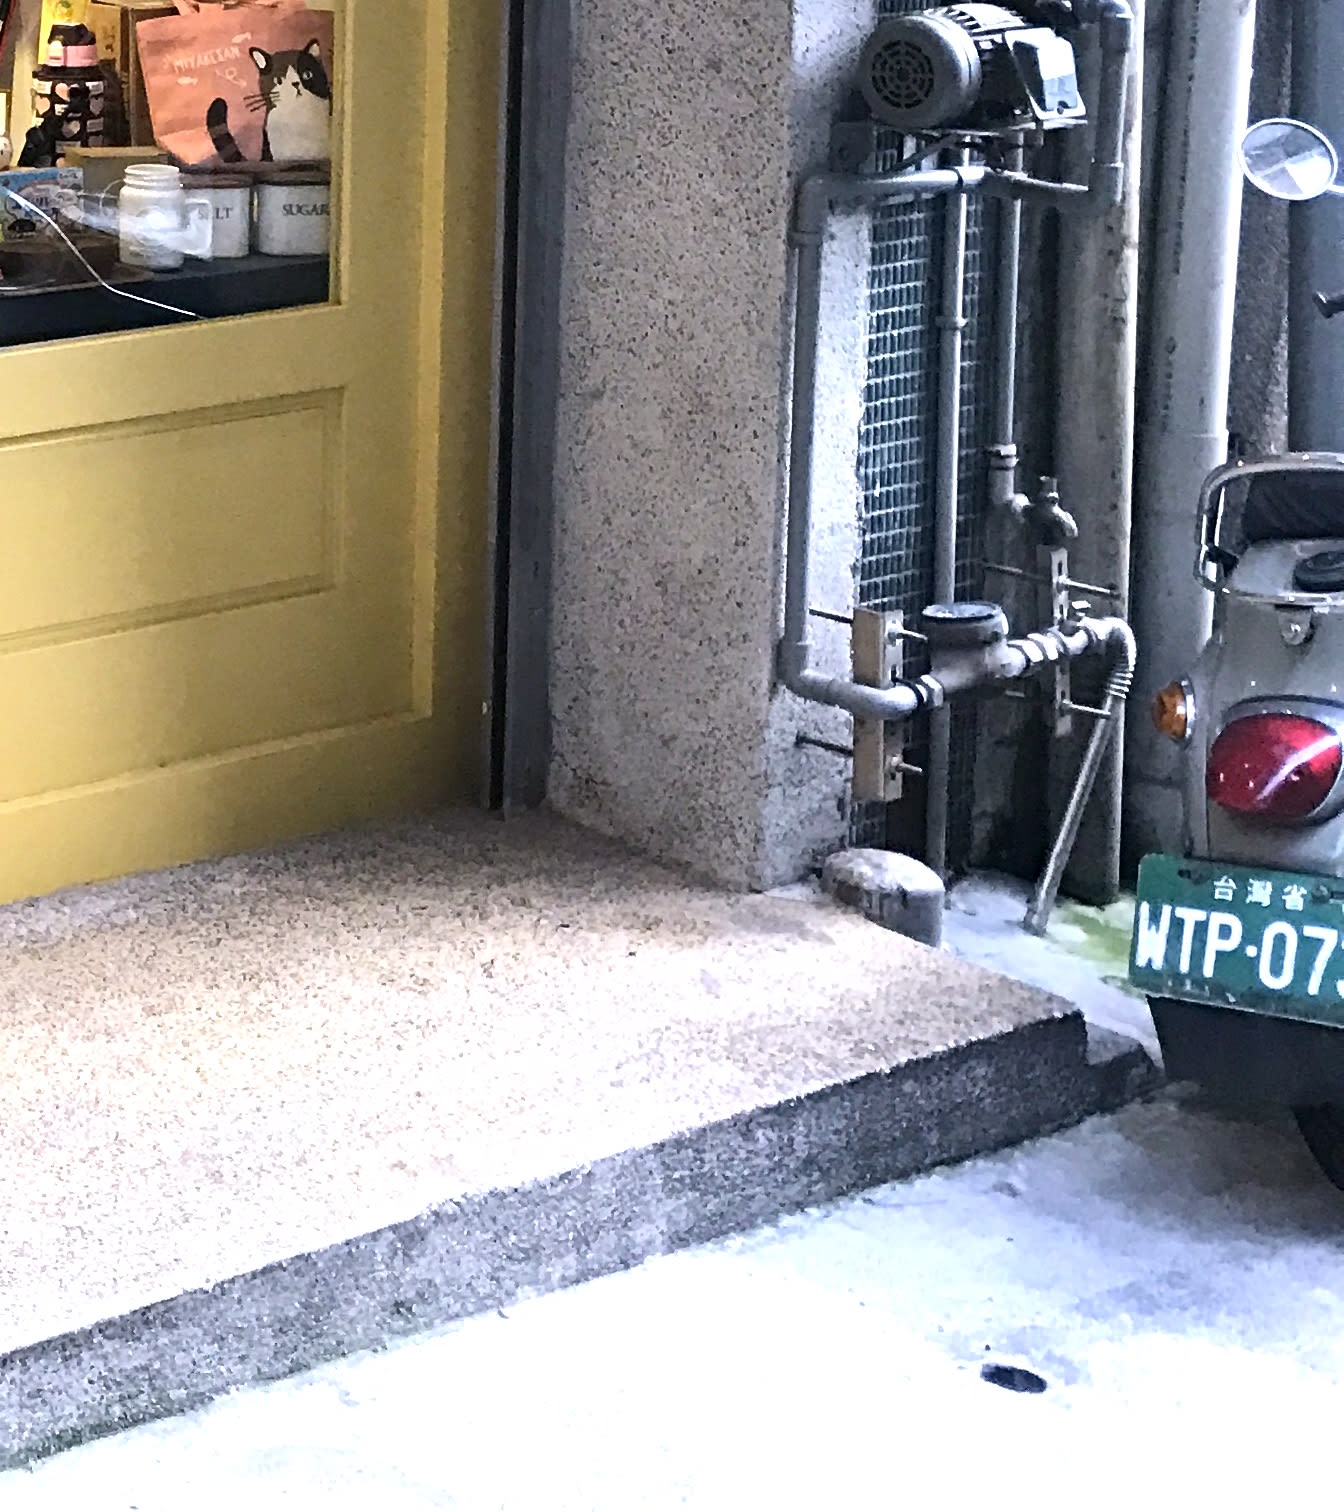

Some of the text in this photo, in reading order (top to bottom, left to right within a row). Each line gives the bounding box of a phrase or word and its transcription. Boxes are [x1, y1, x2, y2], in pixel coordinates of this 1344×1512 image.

[198, 207, 233, 220] SLT
[1213, 874, 1308, 912] 台灣省
